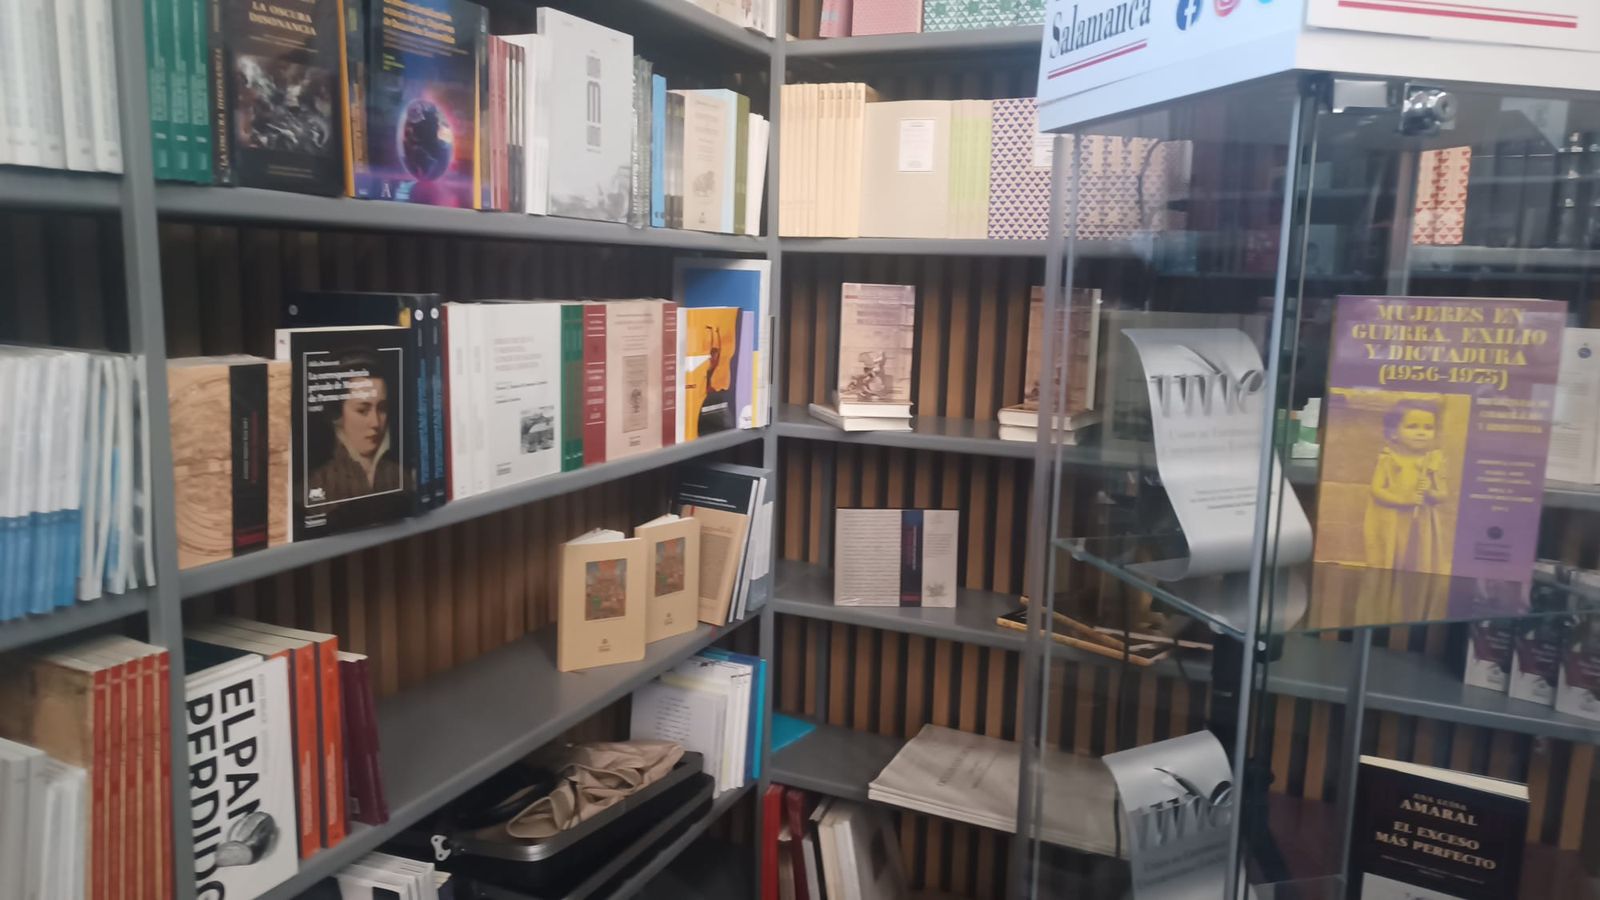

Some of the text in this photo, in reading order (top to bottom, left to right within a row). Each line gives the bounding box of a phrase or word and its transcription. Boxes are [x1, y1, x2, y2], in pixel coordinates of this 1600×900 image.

[1049, 0, 1151, 59] Salamanca
[1378, 304, 1527, 325] MUJERES EN
[1461, 327, 1548, 346] EXILIO
[1364, 343, 1528, 366] Y DICTADURA
[1400, 799, 1478, 825] AMARAL
[1393, 820, 1480, 851] EL EXCESO
[1375, 830, 1408, 848] MÁS
[1412, 840, 1497, 870] PERFECTO
